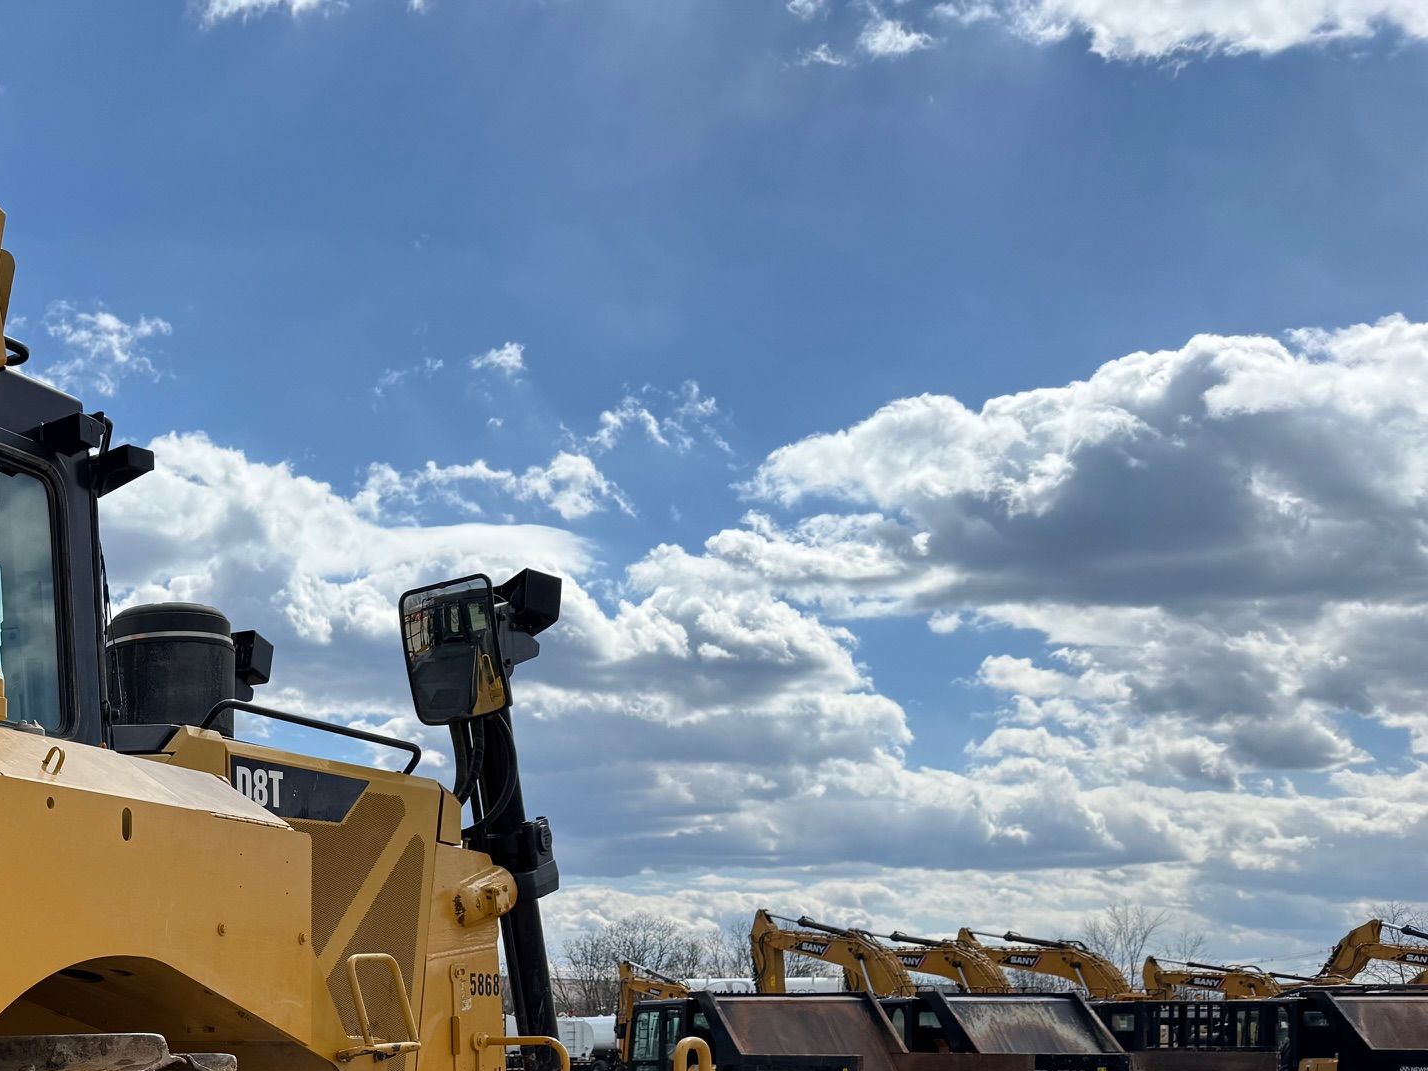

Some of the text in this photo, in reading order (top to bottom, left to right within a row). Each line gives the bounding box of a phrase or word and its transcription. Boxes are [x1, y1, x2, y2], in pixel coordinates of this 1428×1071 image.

[236, 765, 284, 808] D8T
[801, 942, 826, 954] SANY
[1009, 955, 1036, 966] SANY
[469, 972, 500, 997] 5868
[1193, 977, 1219, 987] SANY
